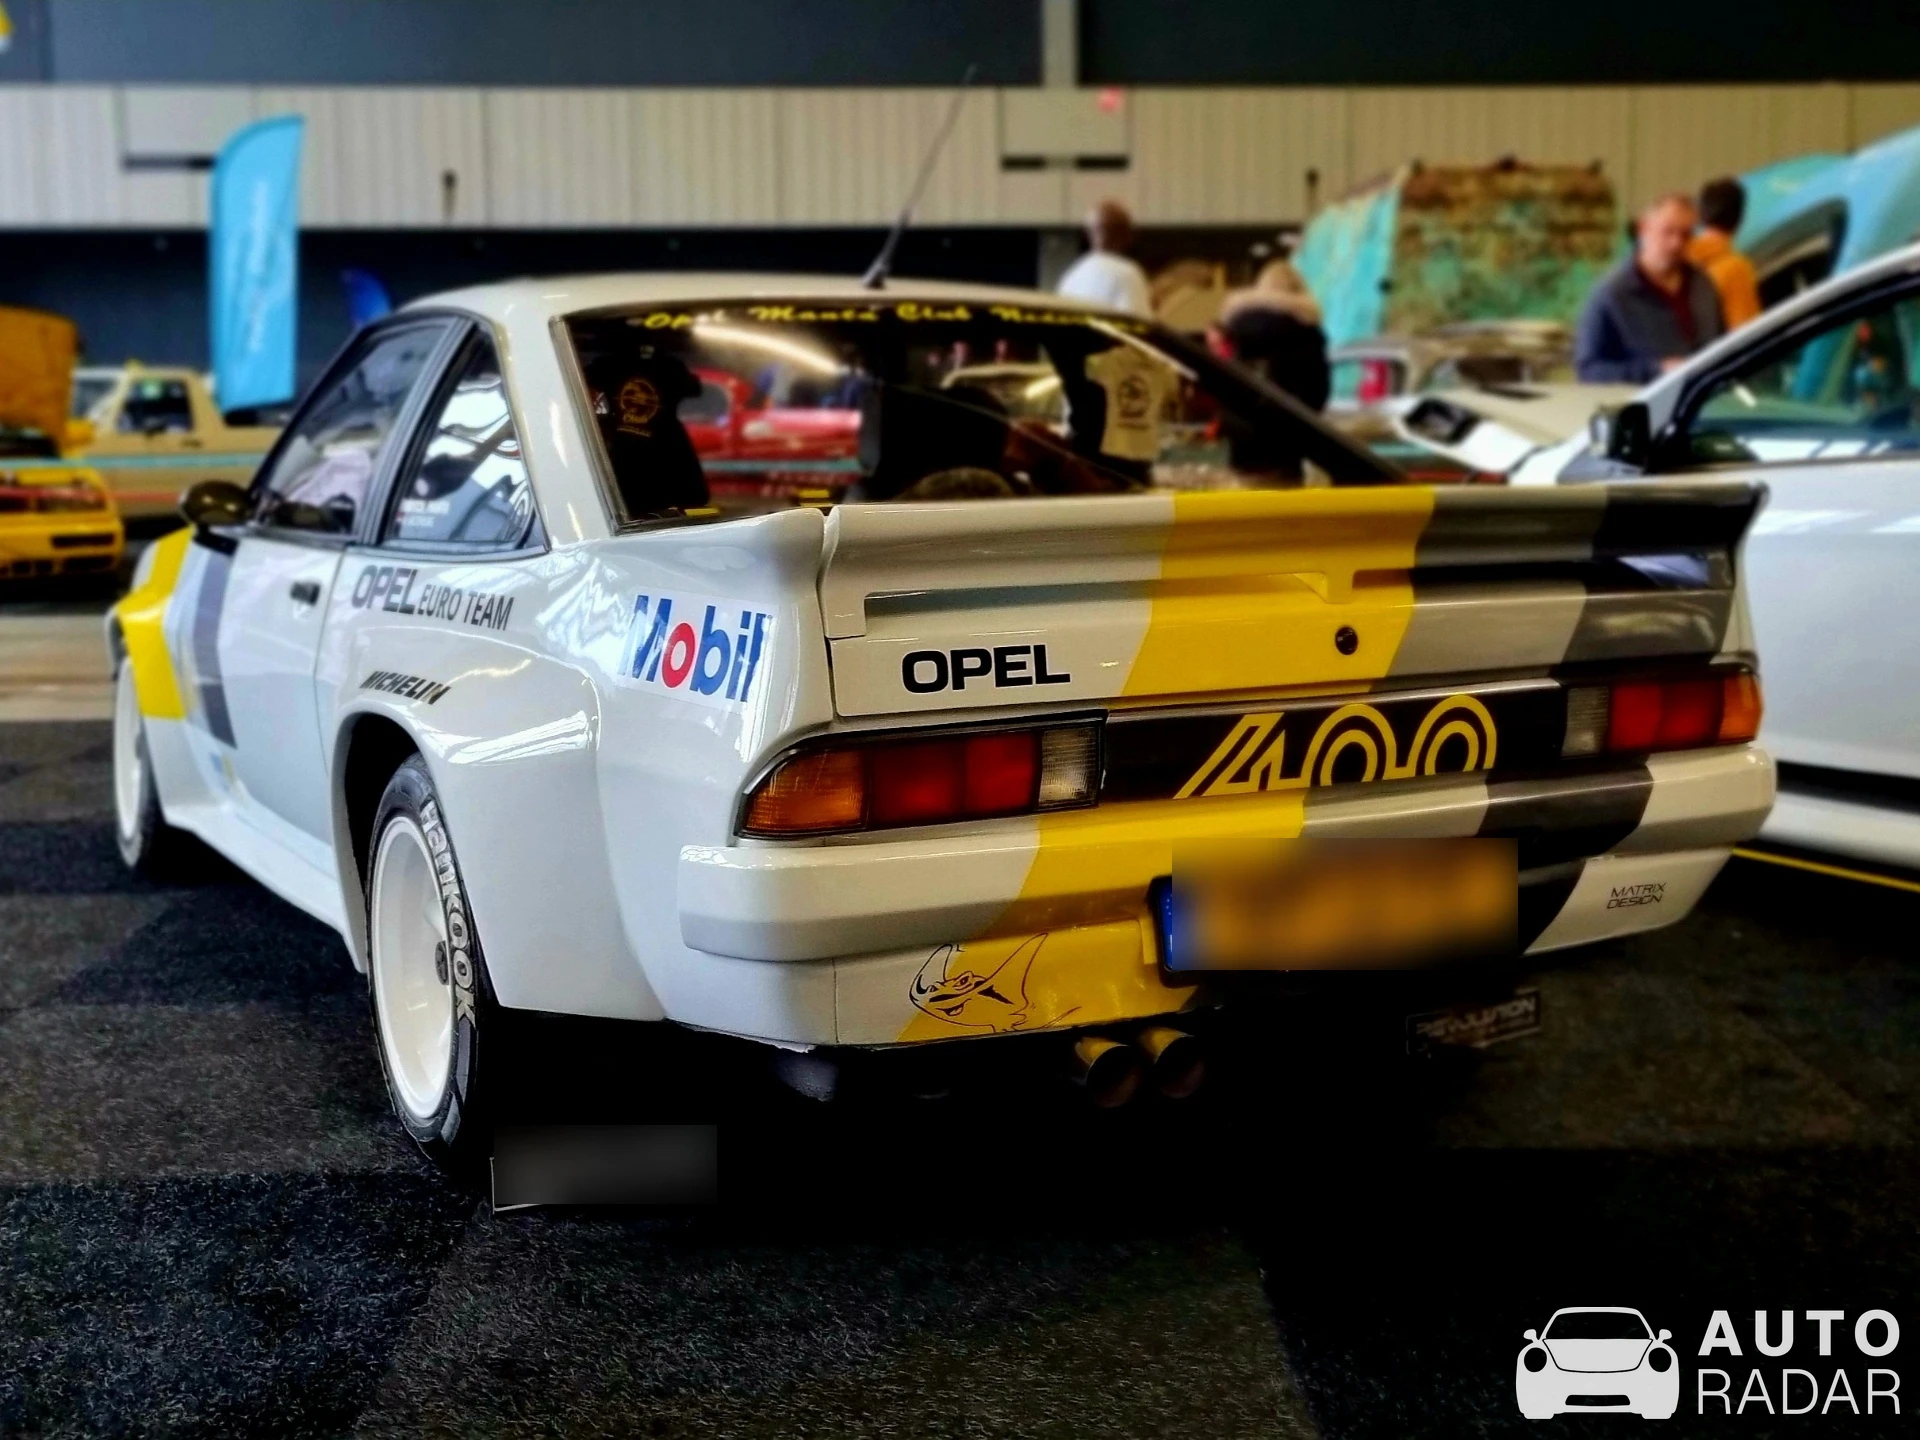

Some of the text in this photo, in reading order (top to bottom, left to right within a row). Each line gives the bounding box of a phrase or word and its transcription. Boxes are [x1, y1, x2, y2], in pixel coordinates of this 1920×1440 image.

[748, 305, 878, 322] Manta
[896, 303, 971, 321] Club
[352, 565, 514, 631] OPEL EURO TEAM
[617, 595, 766, 702] Mobil
[902, 644, 1071, 694] OPEL
[359, 671, 451, 705] MICHELIN
[1173, 694, 1497, 800] 400
[1606, 895, 1663, 909] DESIGN
[1611, 882, 1666, 898] MATRIX
